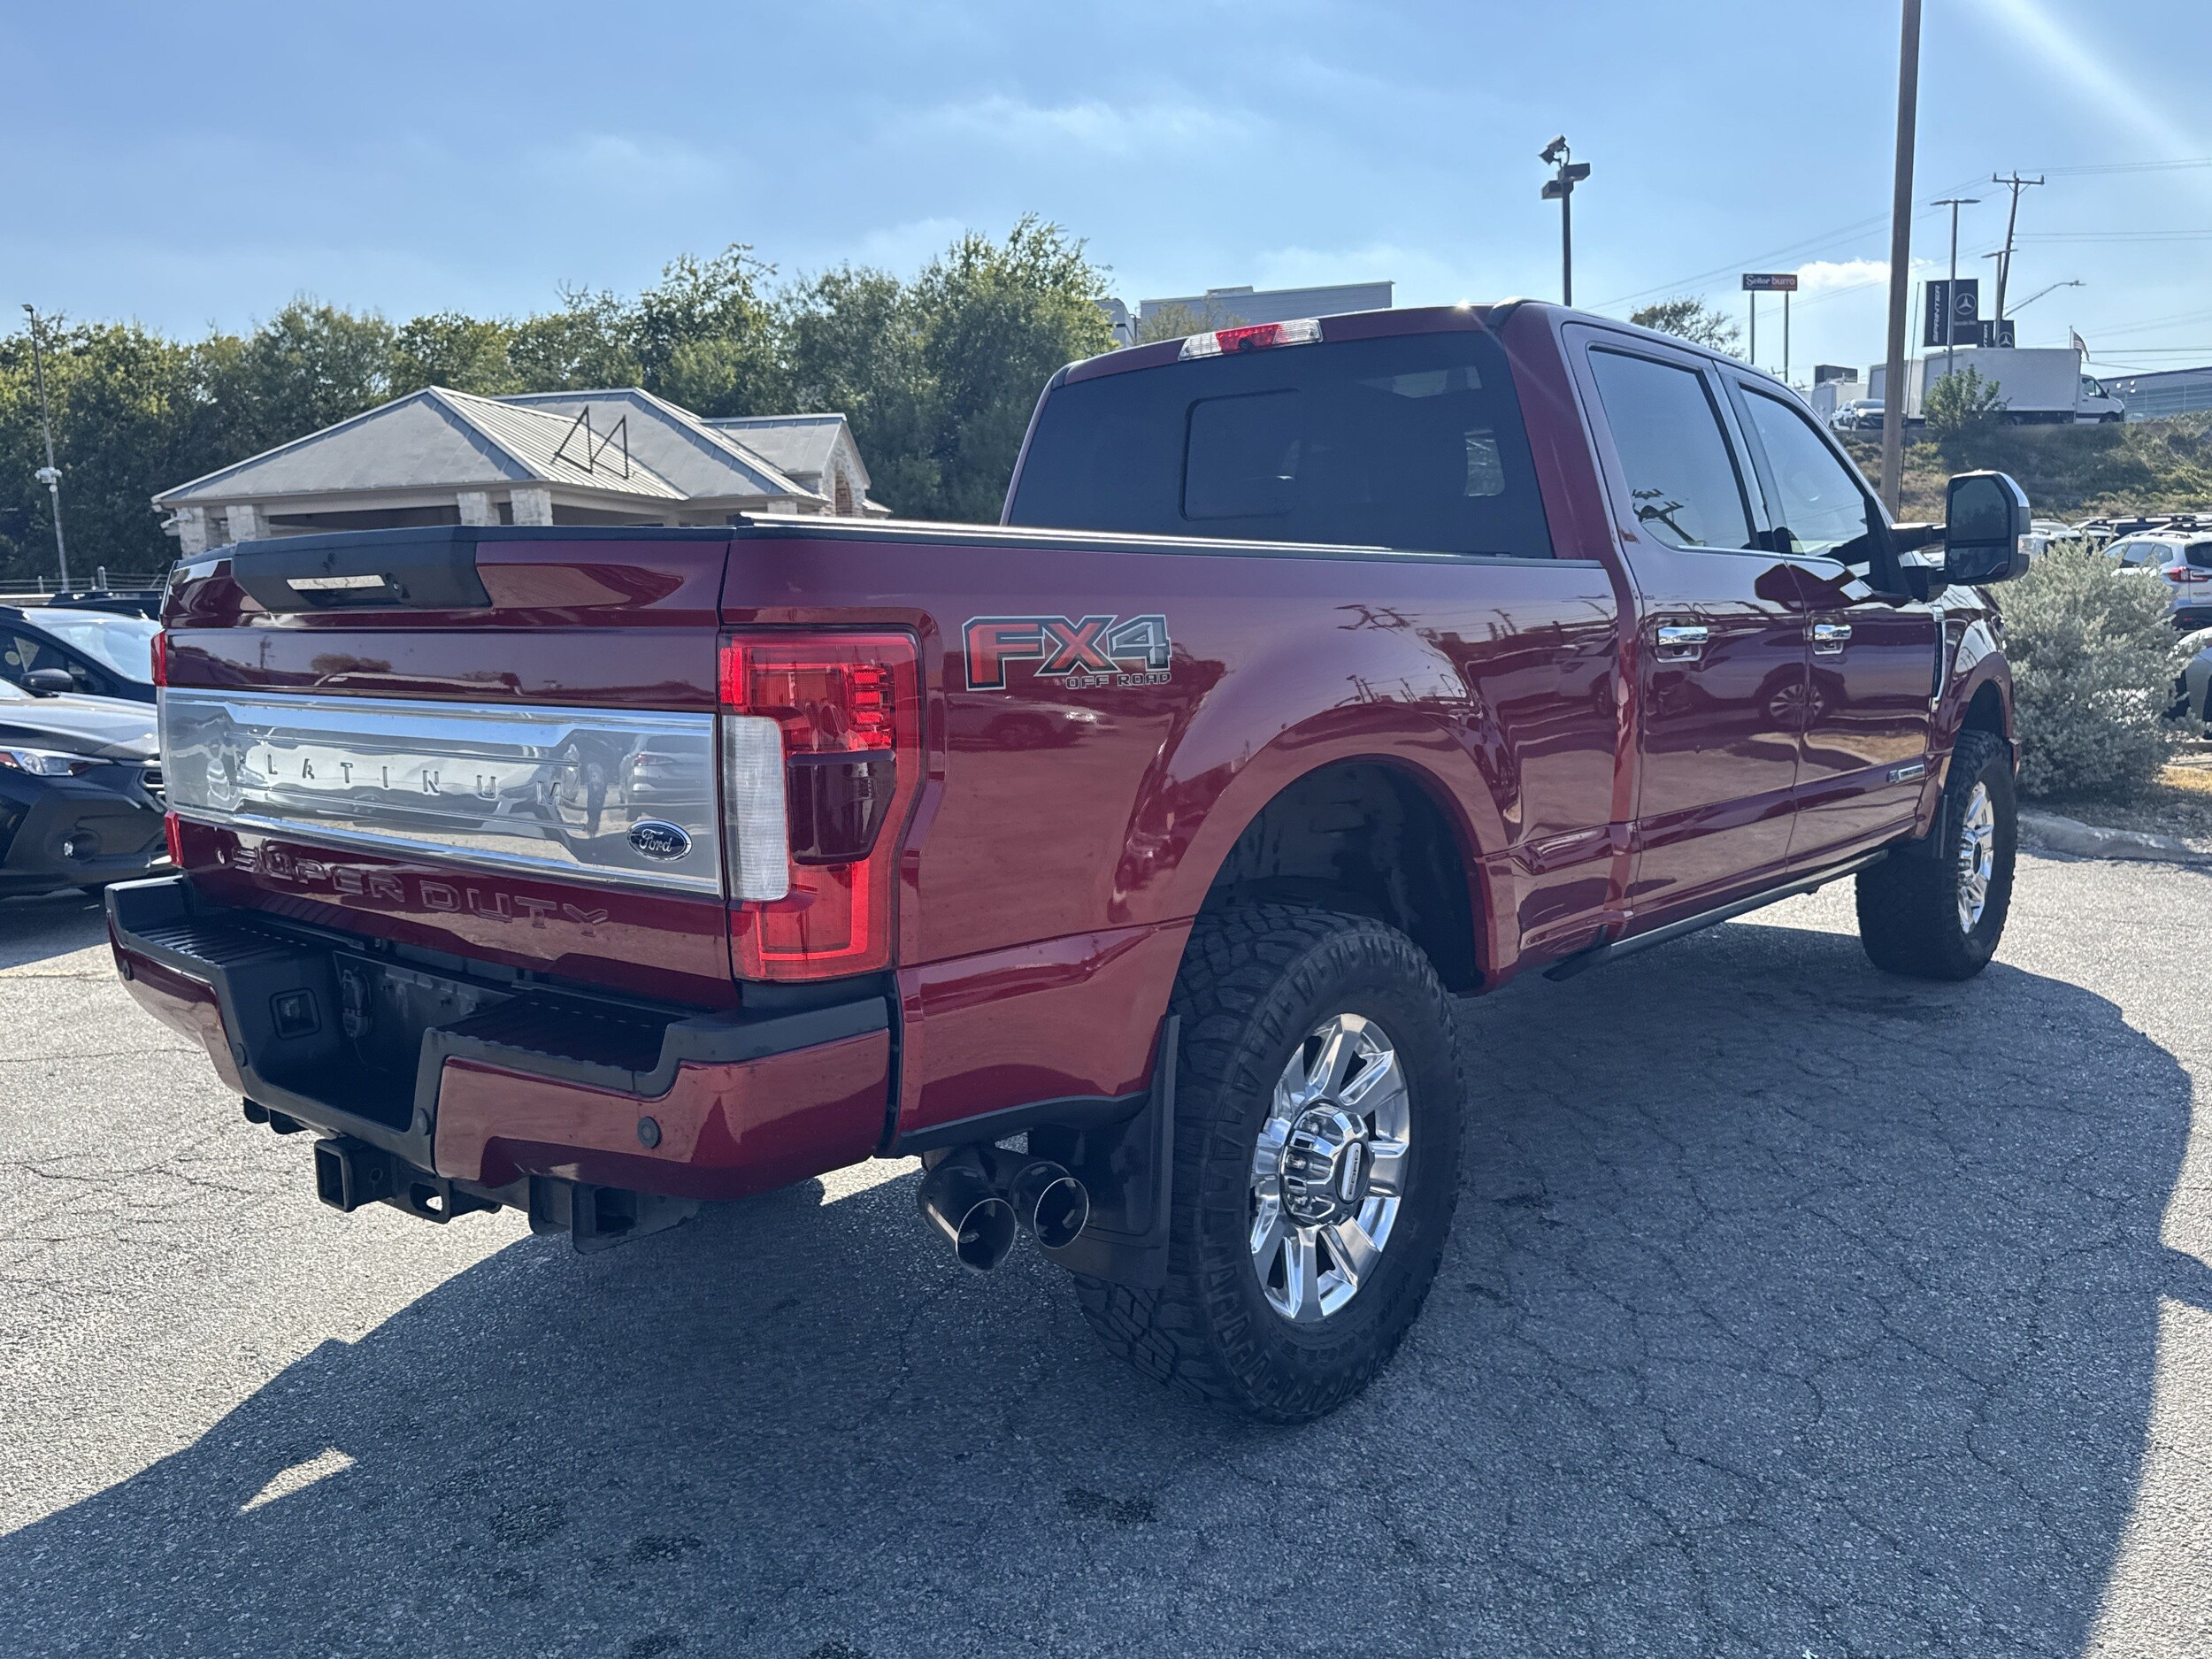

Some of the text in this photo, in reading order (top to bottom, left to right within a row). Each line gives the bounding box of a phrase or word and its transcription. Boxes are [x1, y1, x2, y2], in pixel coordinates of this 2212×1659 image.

[962, 614, 1171, 692] FX4
[1065, 672, 1171, 689] OFF ROAD
[639, 828, 672, 852] Ford
[419, 879, 609, 936] DUTY
